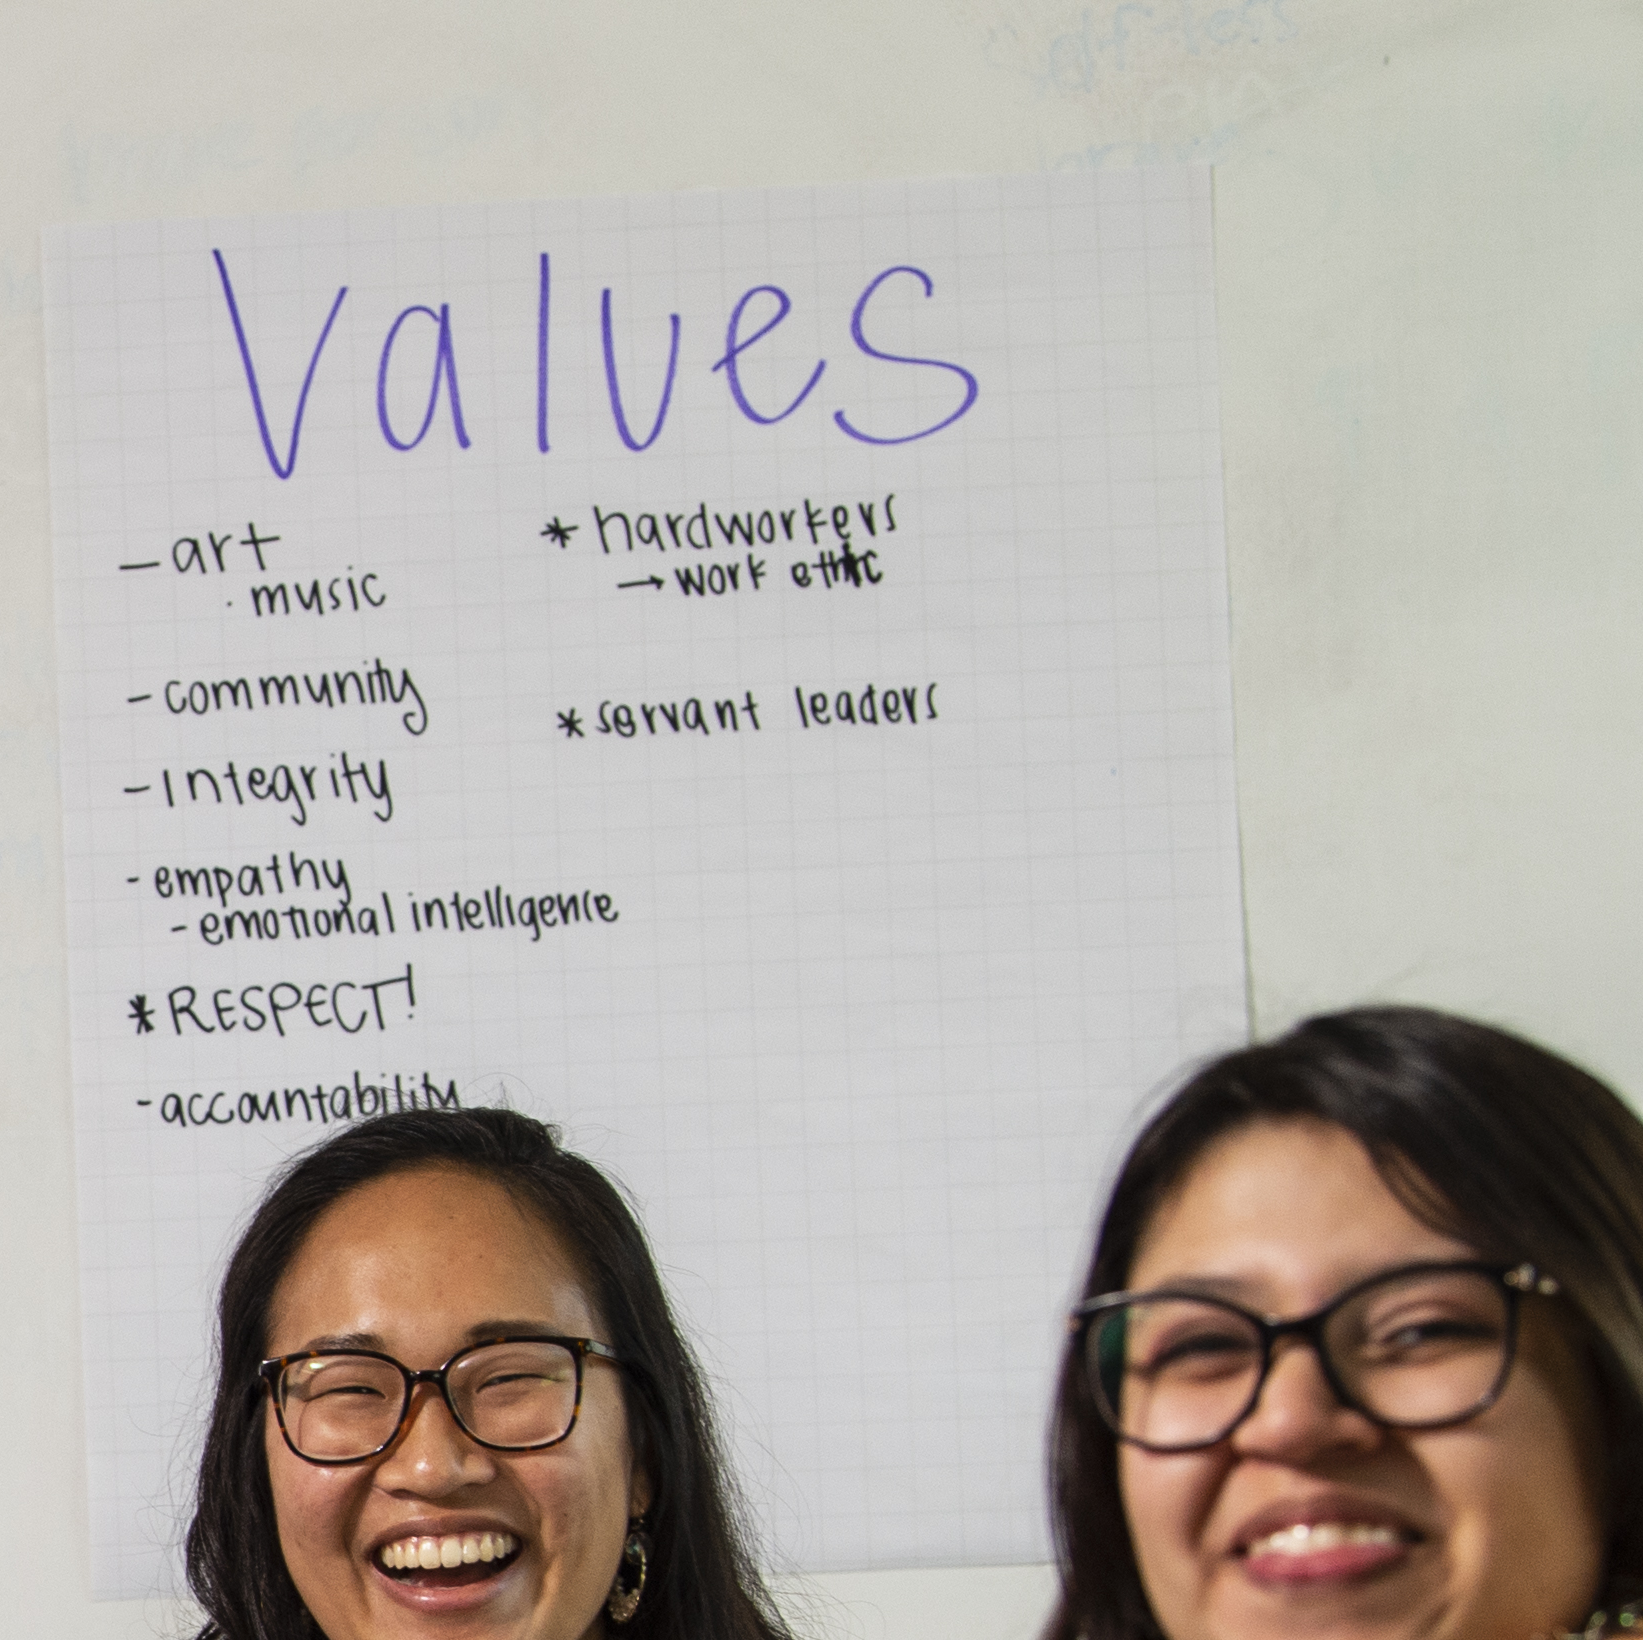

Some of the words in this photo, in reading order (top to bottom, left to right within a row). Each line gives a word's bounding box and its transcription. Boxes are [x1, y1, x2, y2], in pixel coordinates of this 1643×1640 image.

[211, 247, 981, 481] Values
[593, 492, 897, 554] hardworkers
[251, 565, 386, 617] music
[674, 552, 767, 598] work
[595, 690, 761, 739] servant
[795, 682, 938, 729] leaders
[410, 885, 620, 942] intelligence
